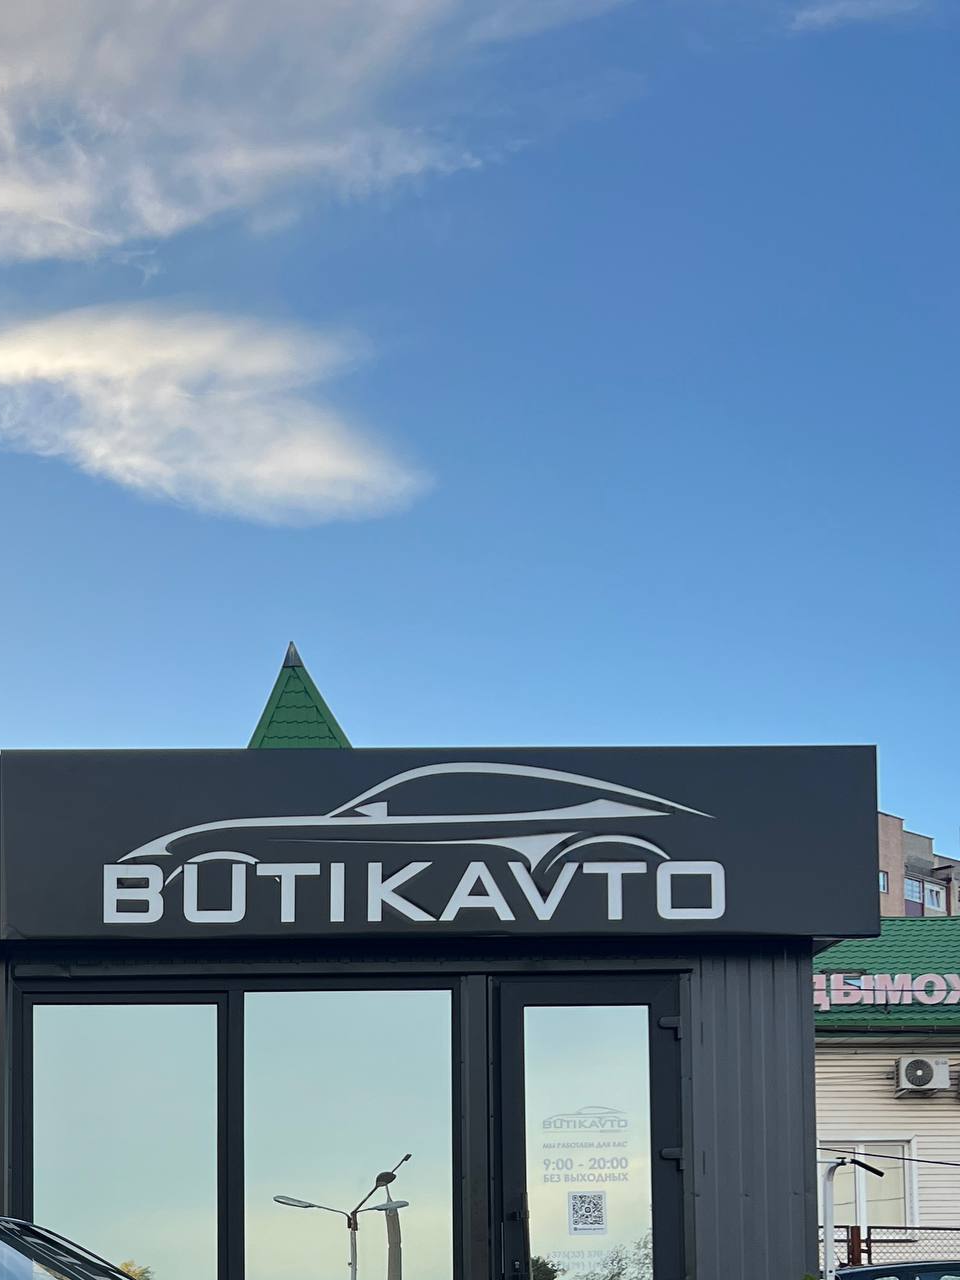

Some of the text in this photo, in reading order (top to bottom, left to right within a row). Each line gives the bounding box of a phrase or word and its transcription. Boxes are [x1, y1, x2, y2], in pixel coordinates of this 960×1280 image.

[102, 859, 726, 924] BUTIKAVTO
[542, 1118, 629, 1130] BUTIKAVTO
[543, 1157, 574, 1171] 9:00
[588, 1156, 629, 1170] 20:00
[543, 1172, 629, 1183] БЕЗ ВЫХОДНЫХ
